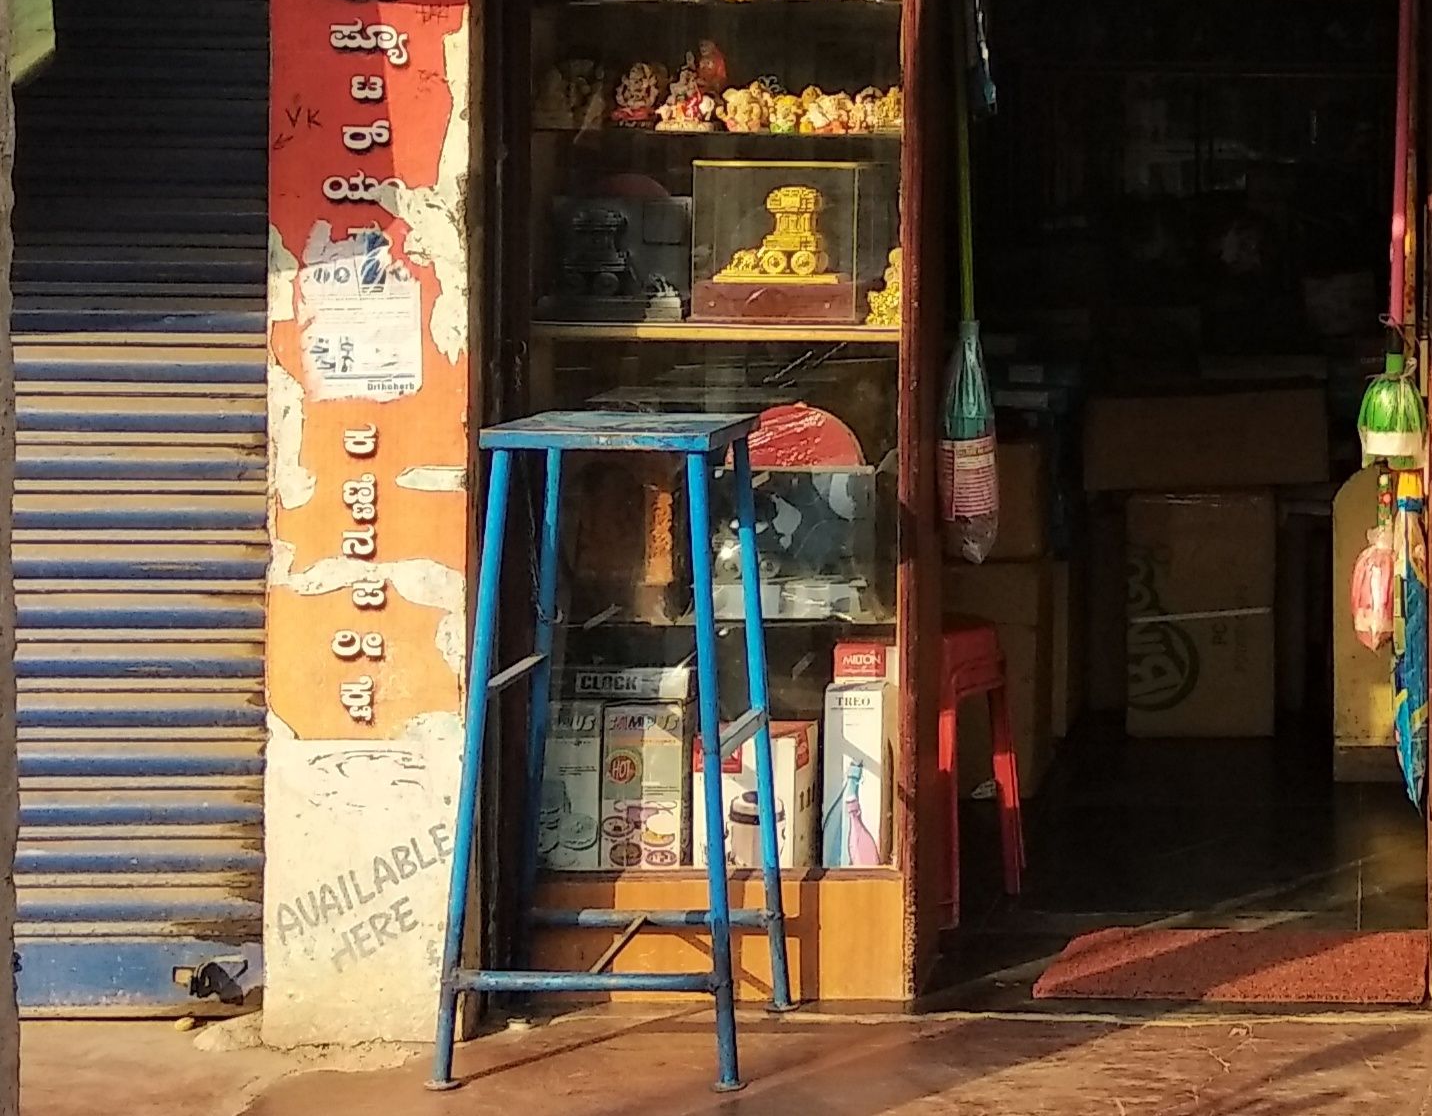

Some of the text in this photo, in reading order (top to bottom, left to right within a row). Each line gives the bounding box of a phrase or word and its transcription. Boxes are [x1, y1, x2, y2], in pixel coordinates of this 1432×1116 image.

[842, 653, 882, 666] MILTON
[835, 696, 871, 707] TREO
[275, 821, 455, 945] AVAILABLE
[331, 896, 419, 974] HERE
